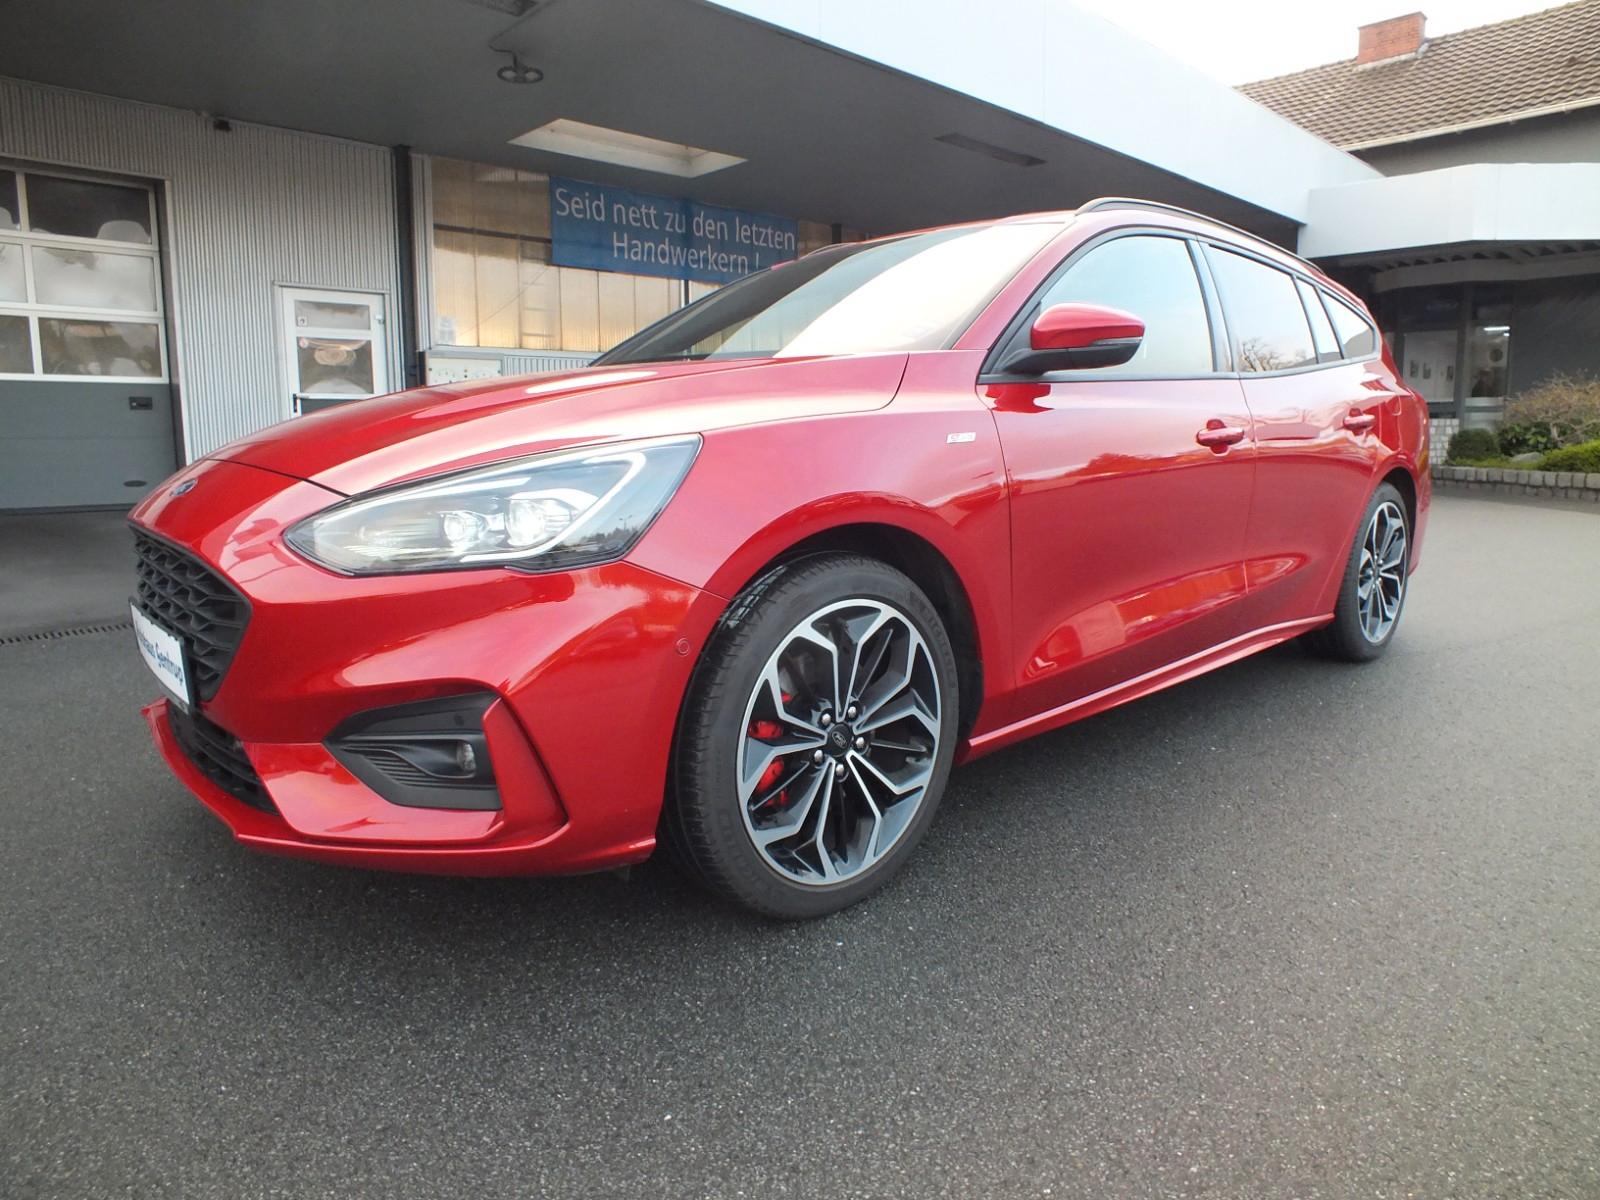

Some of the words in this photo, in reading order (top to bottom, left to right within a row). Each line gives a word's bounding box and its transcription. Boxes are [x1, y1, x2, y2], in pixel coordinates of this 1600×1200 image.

[555, 187, 606, 222] Seid
[613, 204, 659, 230] nett
[664, 212, 687, 233] zu
[692, 210, 728, 241] den
[735, 216, 796, 250] letzten
[613, 231, 749, 275] Handwerkern
